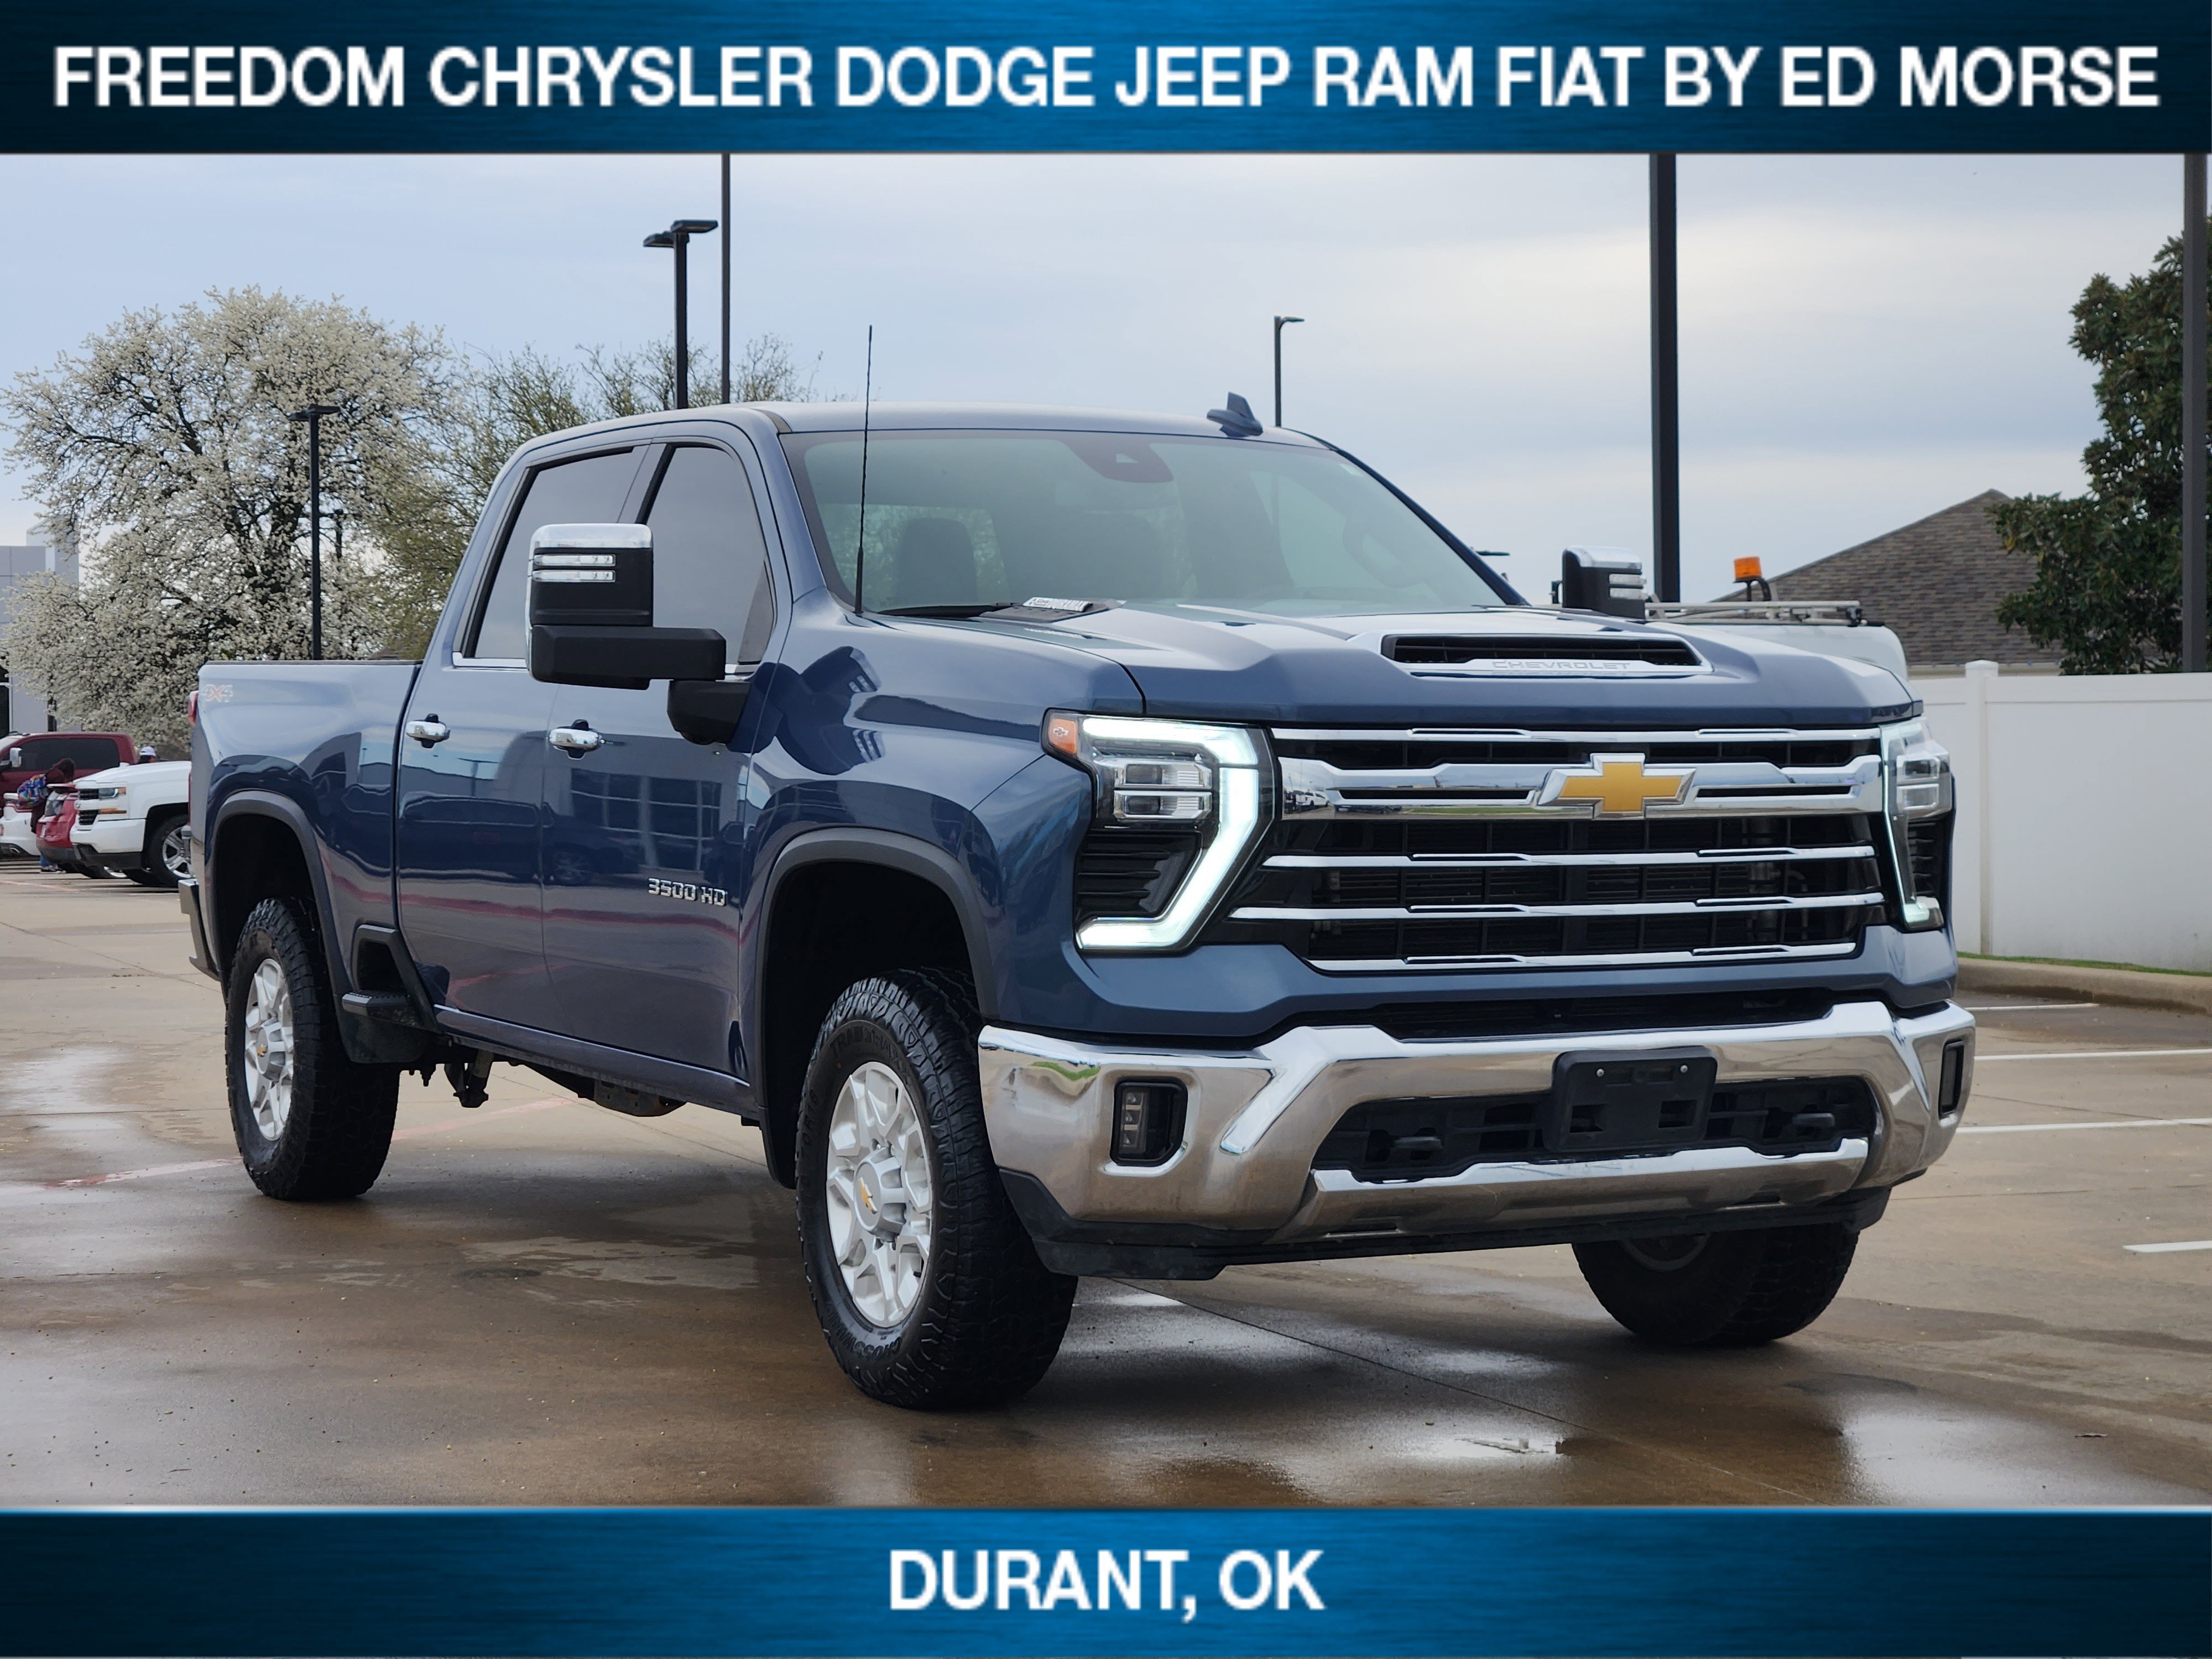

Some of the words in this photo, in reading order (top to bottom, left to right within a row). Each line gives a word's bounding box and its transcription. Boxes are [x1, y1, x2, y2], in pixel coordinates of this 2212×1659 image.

[1491, 660, 1631, 670] CHEVROLET
[648, 878, 697, 901] 3500
[701, 886, 727, 907] HD
